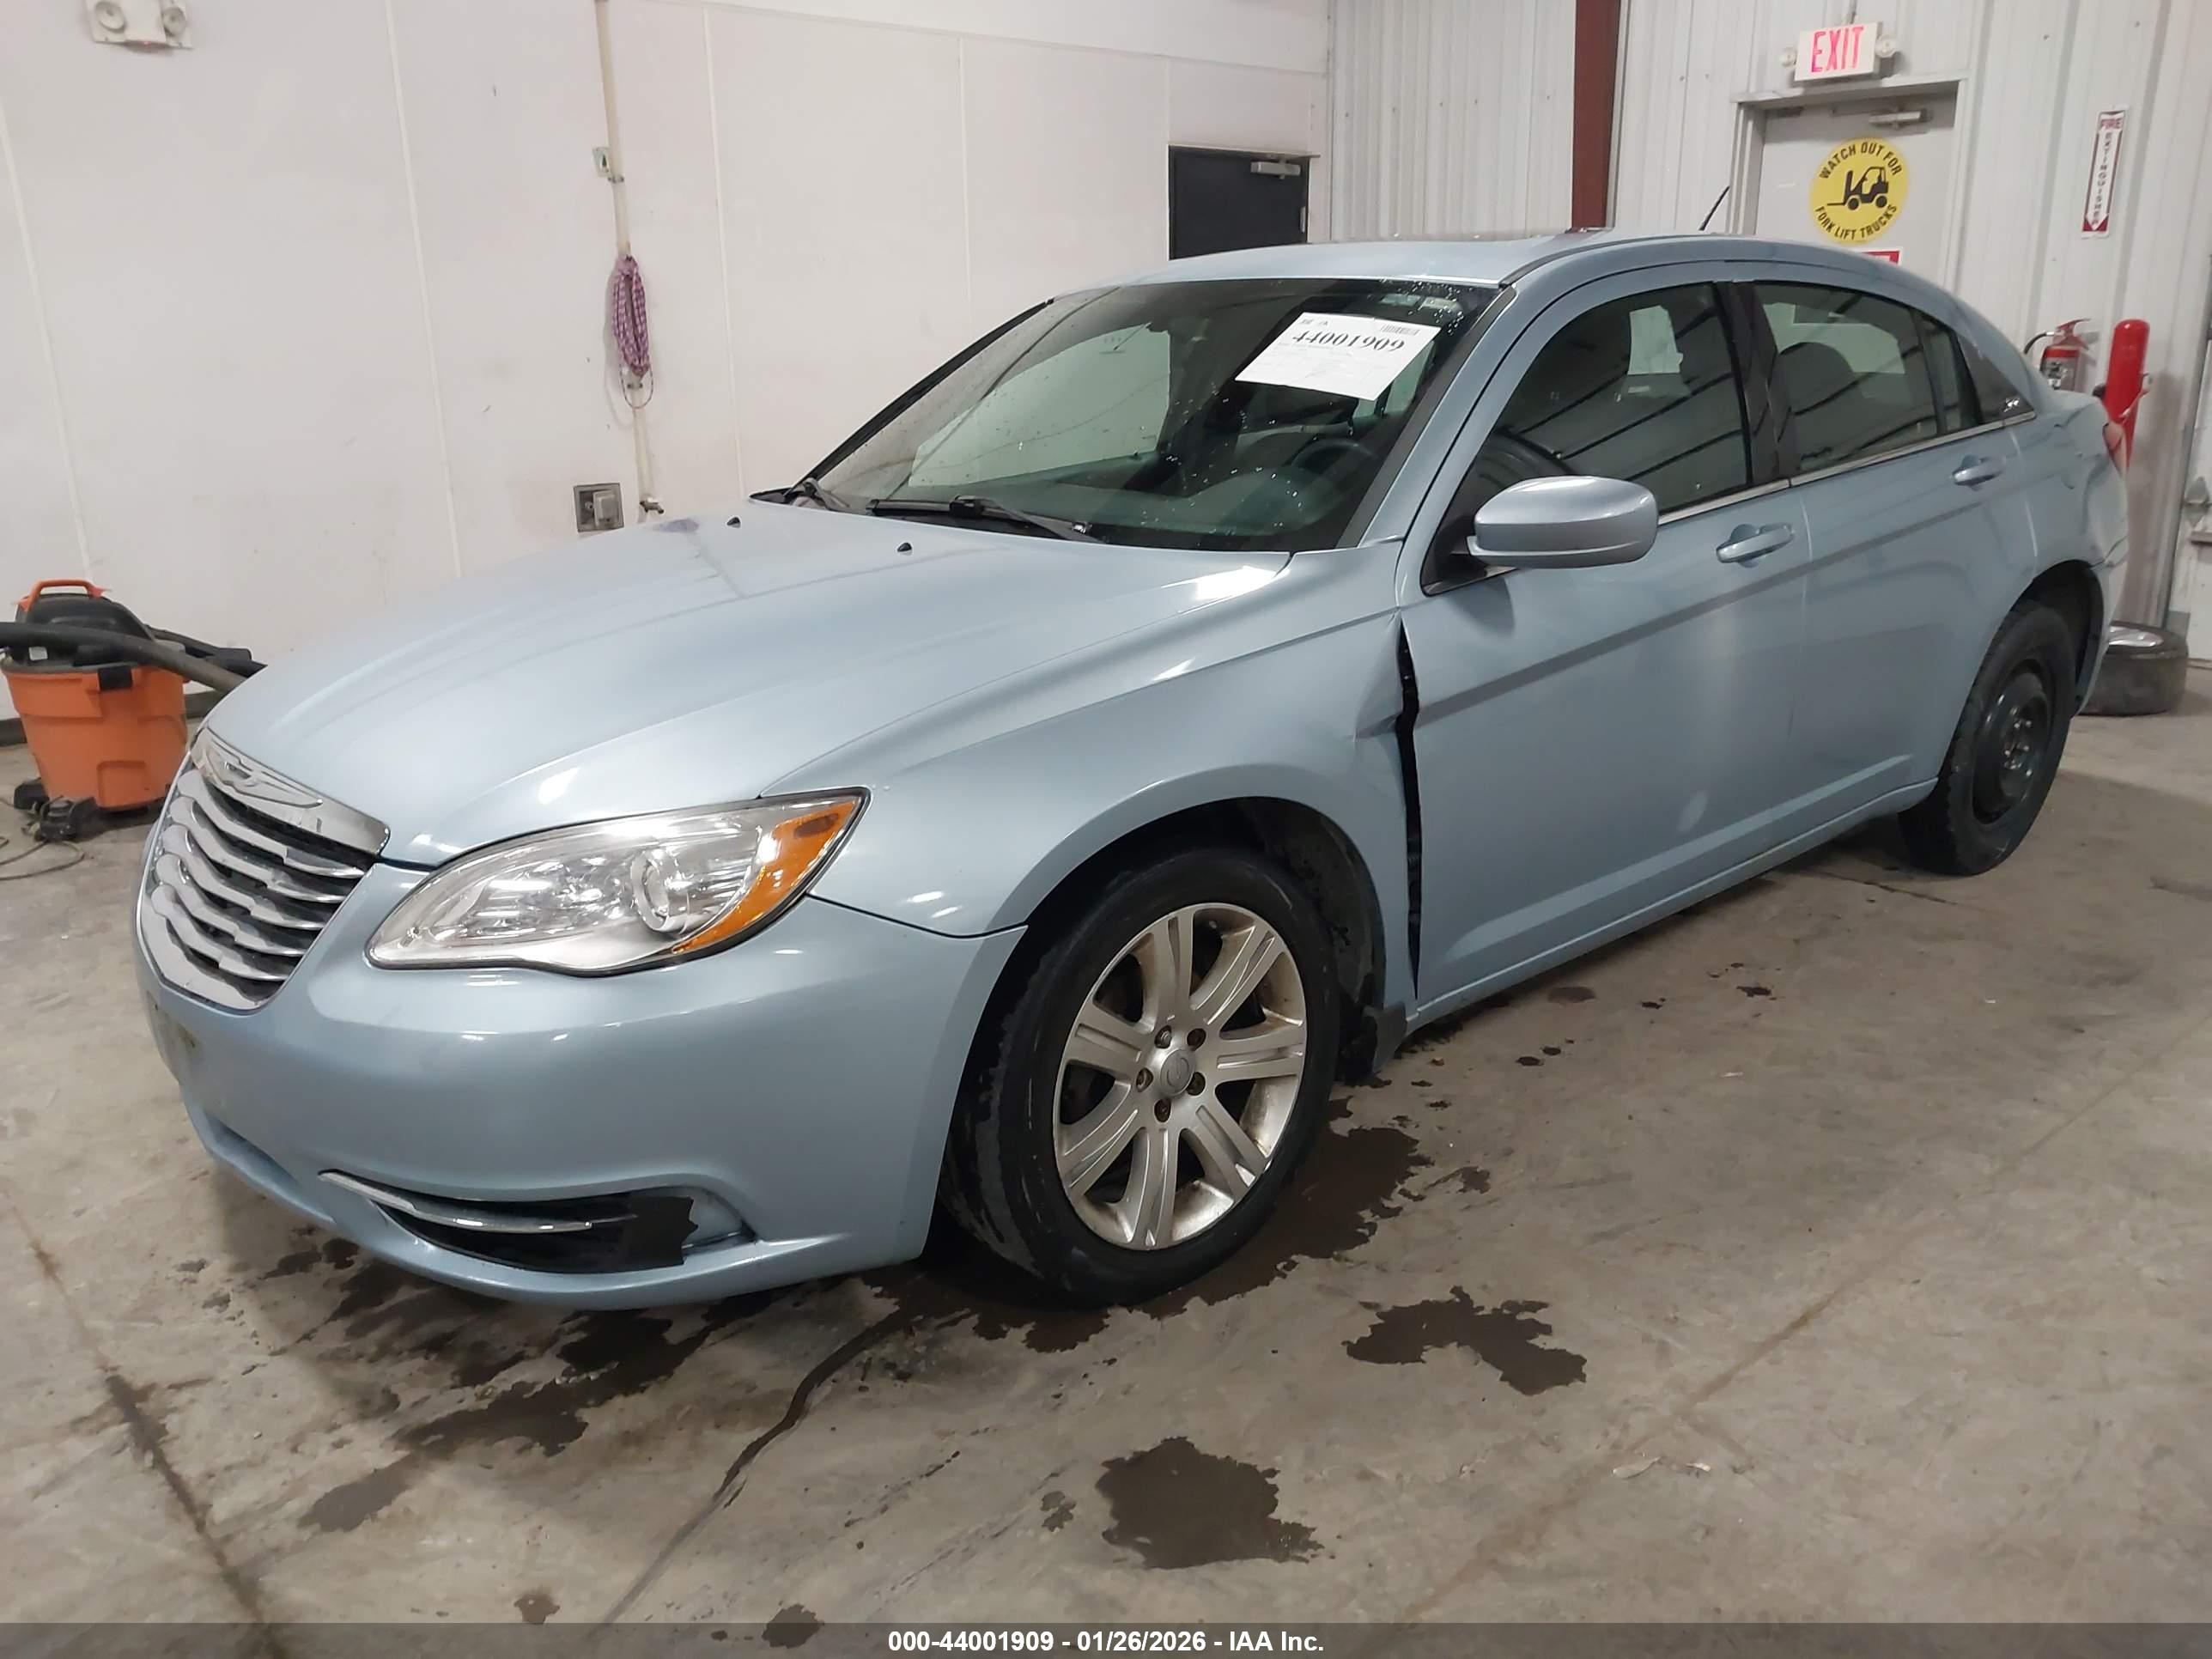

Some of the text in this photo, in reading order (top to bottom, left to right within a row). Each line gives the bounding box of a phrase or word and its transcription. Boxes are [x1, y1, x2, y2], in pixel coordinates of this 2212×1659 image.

[1810, 26, 1864, 73] EXIT
[2100, 118, 2123, 130] FIRE
[1819, 142, 1903, 179] WATCH OUT FOR
[1815, 204, 1898, 240] FORK LIFT TRUCKS
[1291, 330, 1405, 351] 44001909
